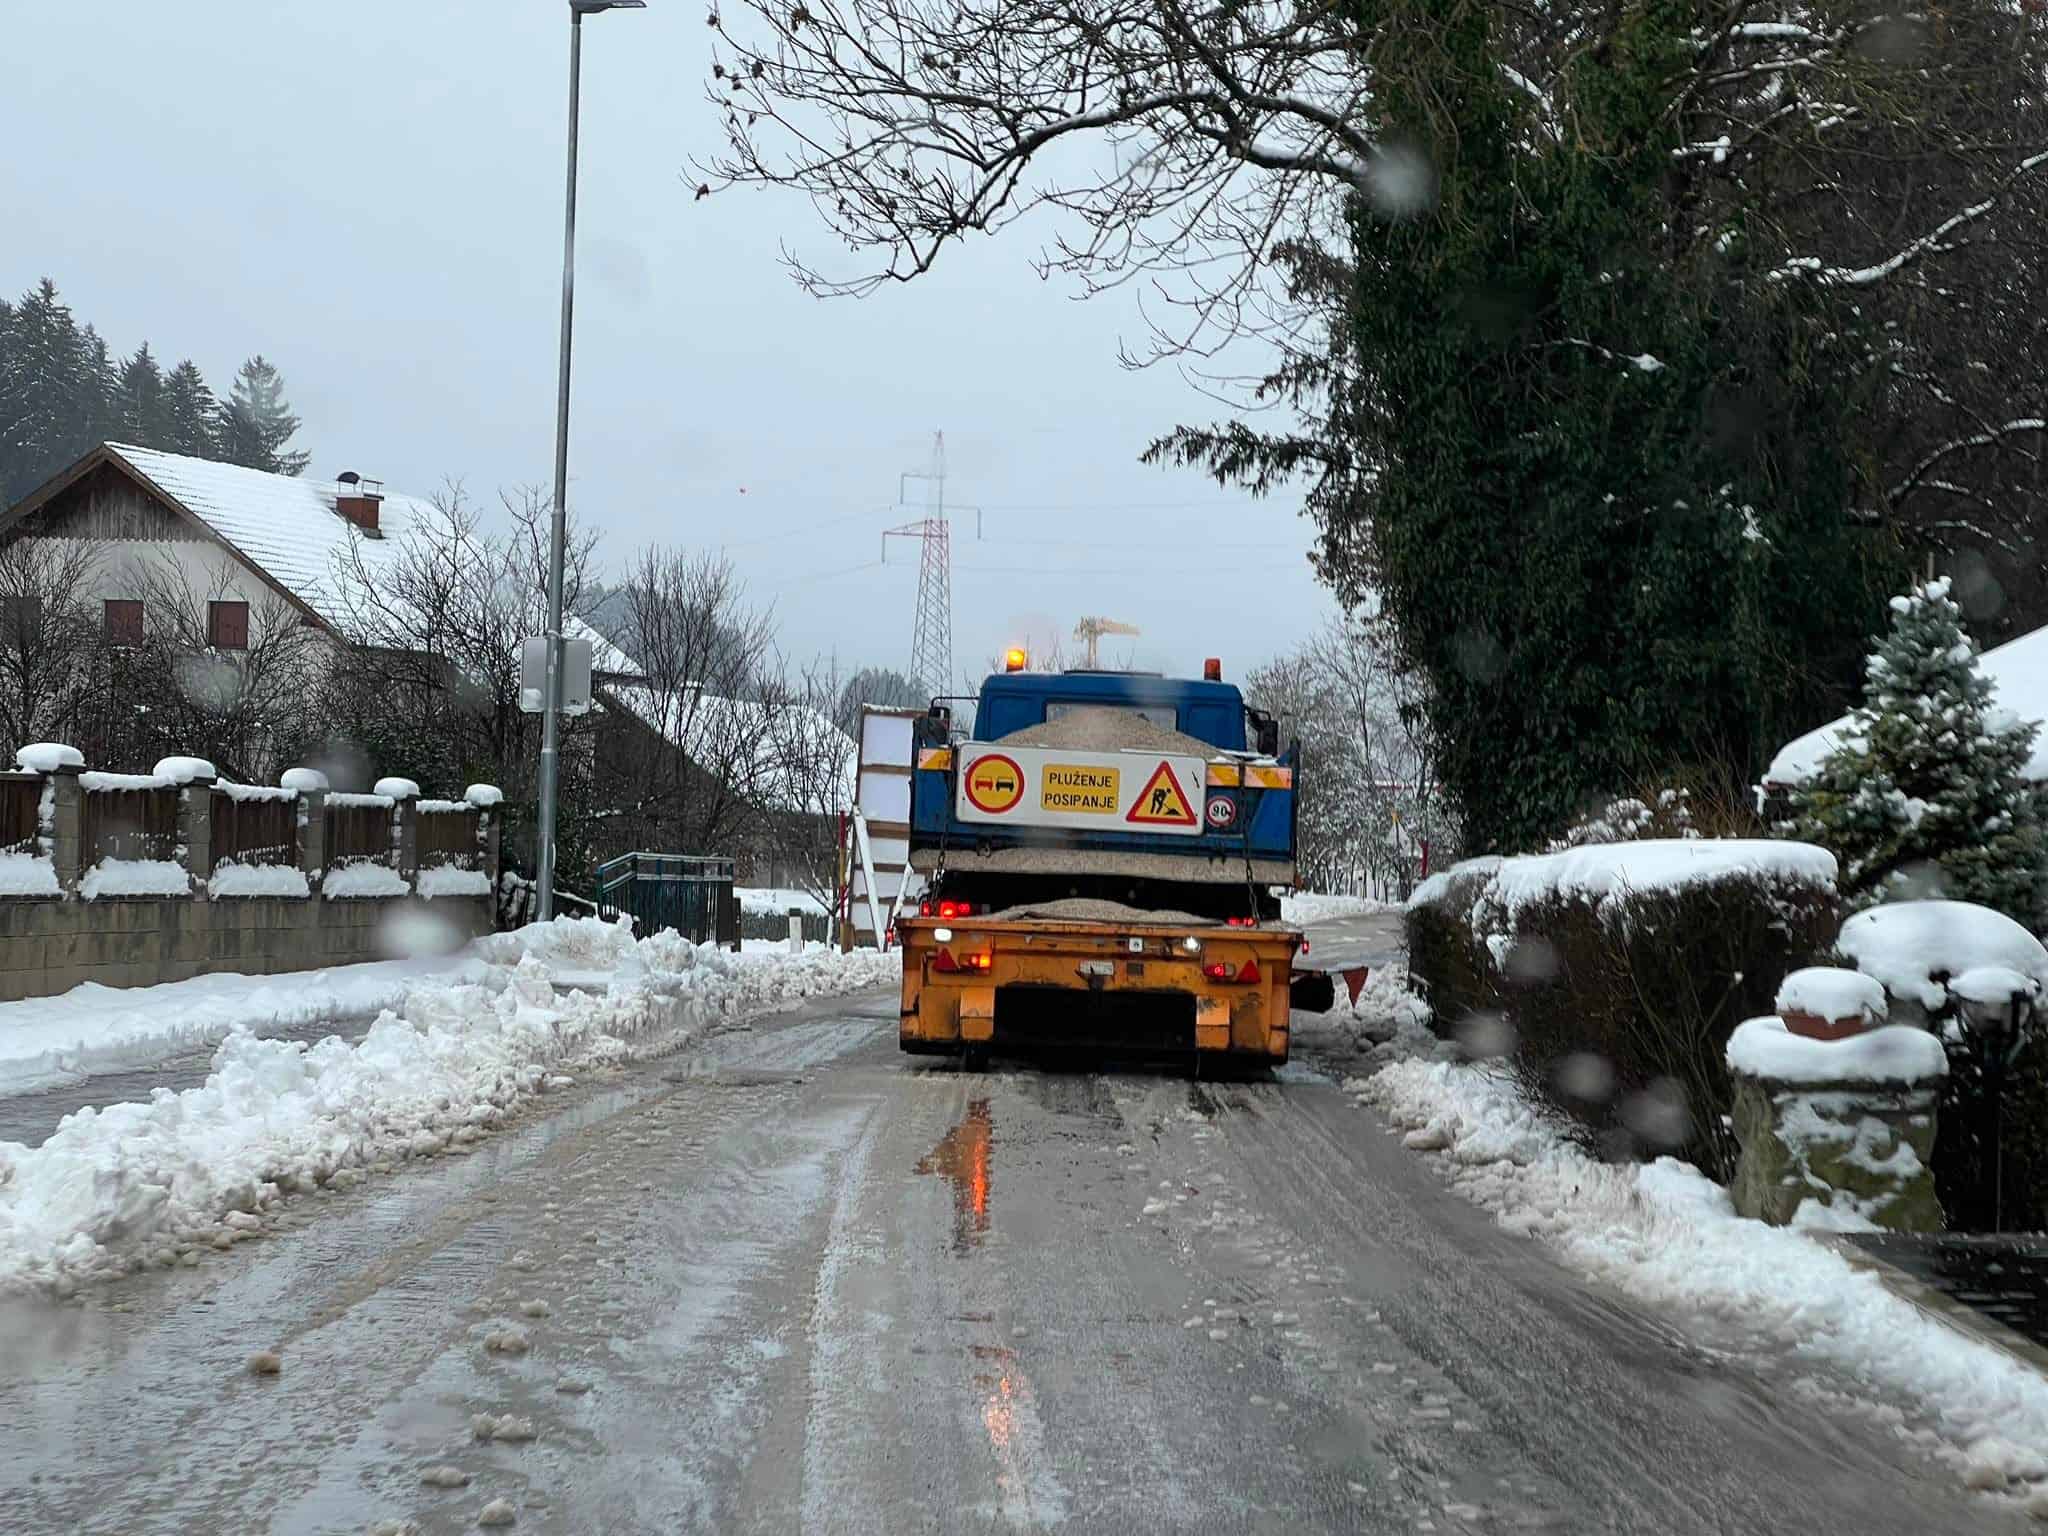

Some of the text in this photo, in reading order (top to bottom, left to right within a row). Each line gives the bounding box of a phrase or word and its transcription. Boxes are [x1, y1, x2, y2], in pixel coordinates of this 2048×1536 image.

[1049, 771, 1112, 787] PLUŽENJE
[1044, 792, 1115, 808] POSIPANJE
[1213, 804, 1228, 817] 90
